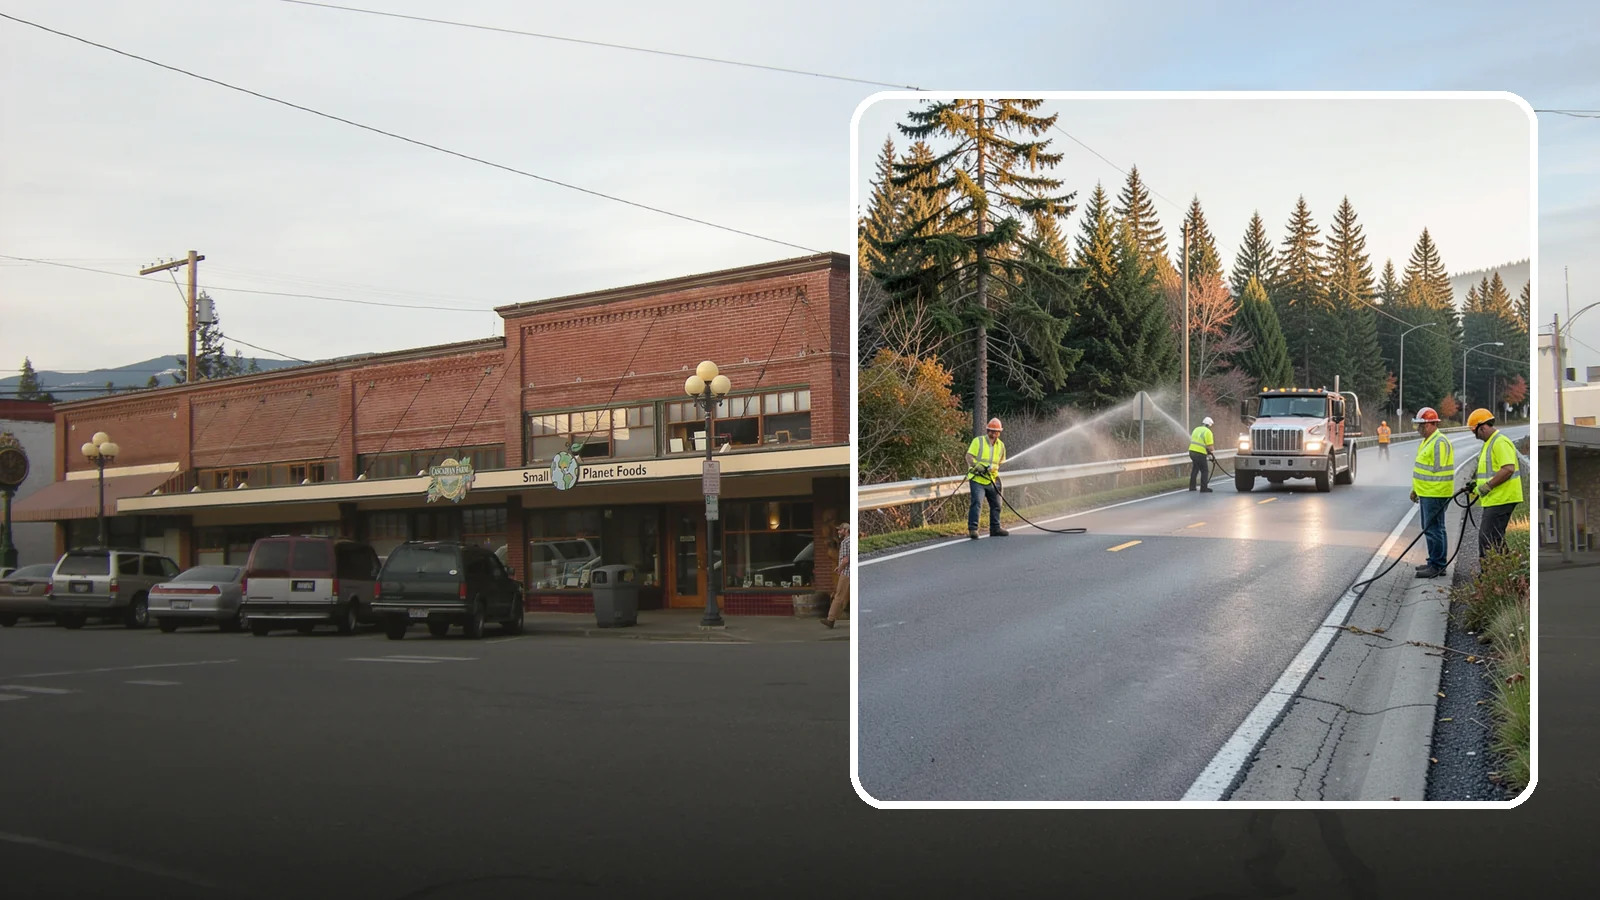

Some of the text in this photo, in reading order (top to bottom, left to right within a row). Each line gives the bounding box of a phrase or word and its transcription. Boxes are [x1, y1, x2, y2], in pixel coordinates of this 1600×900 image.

[523, 464, 647, 483] Small Planet Foods
